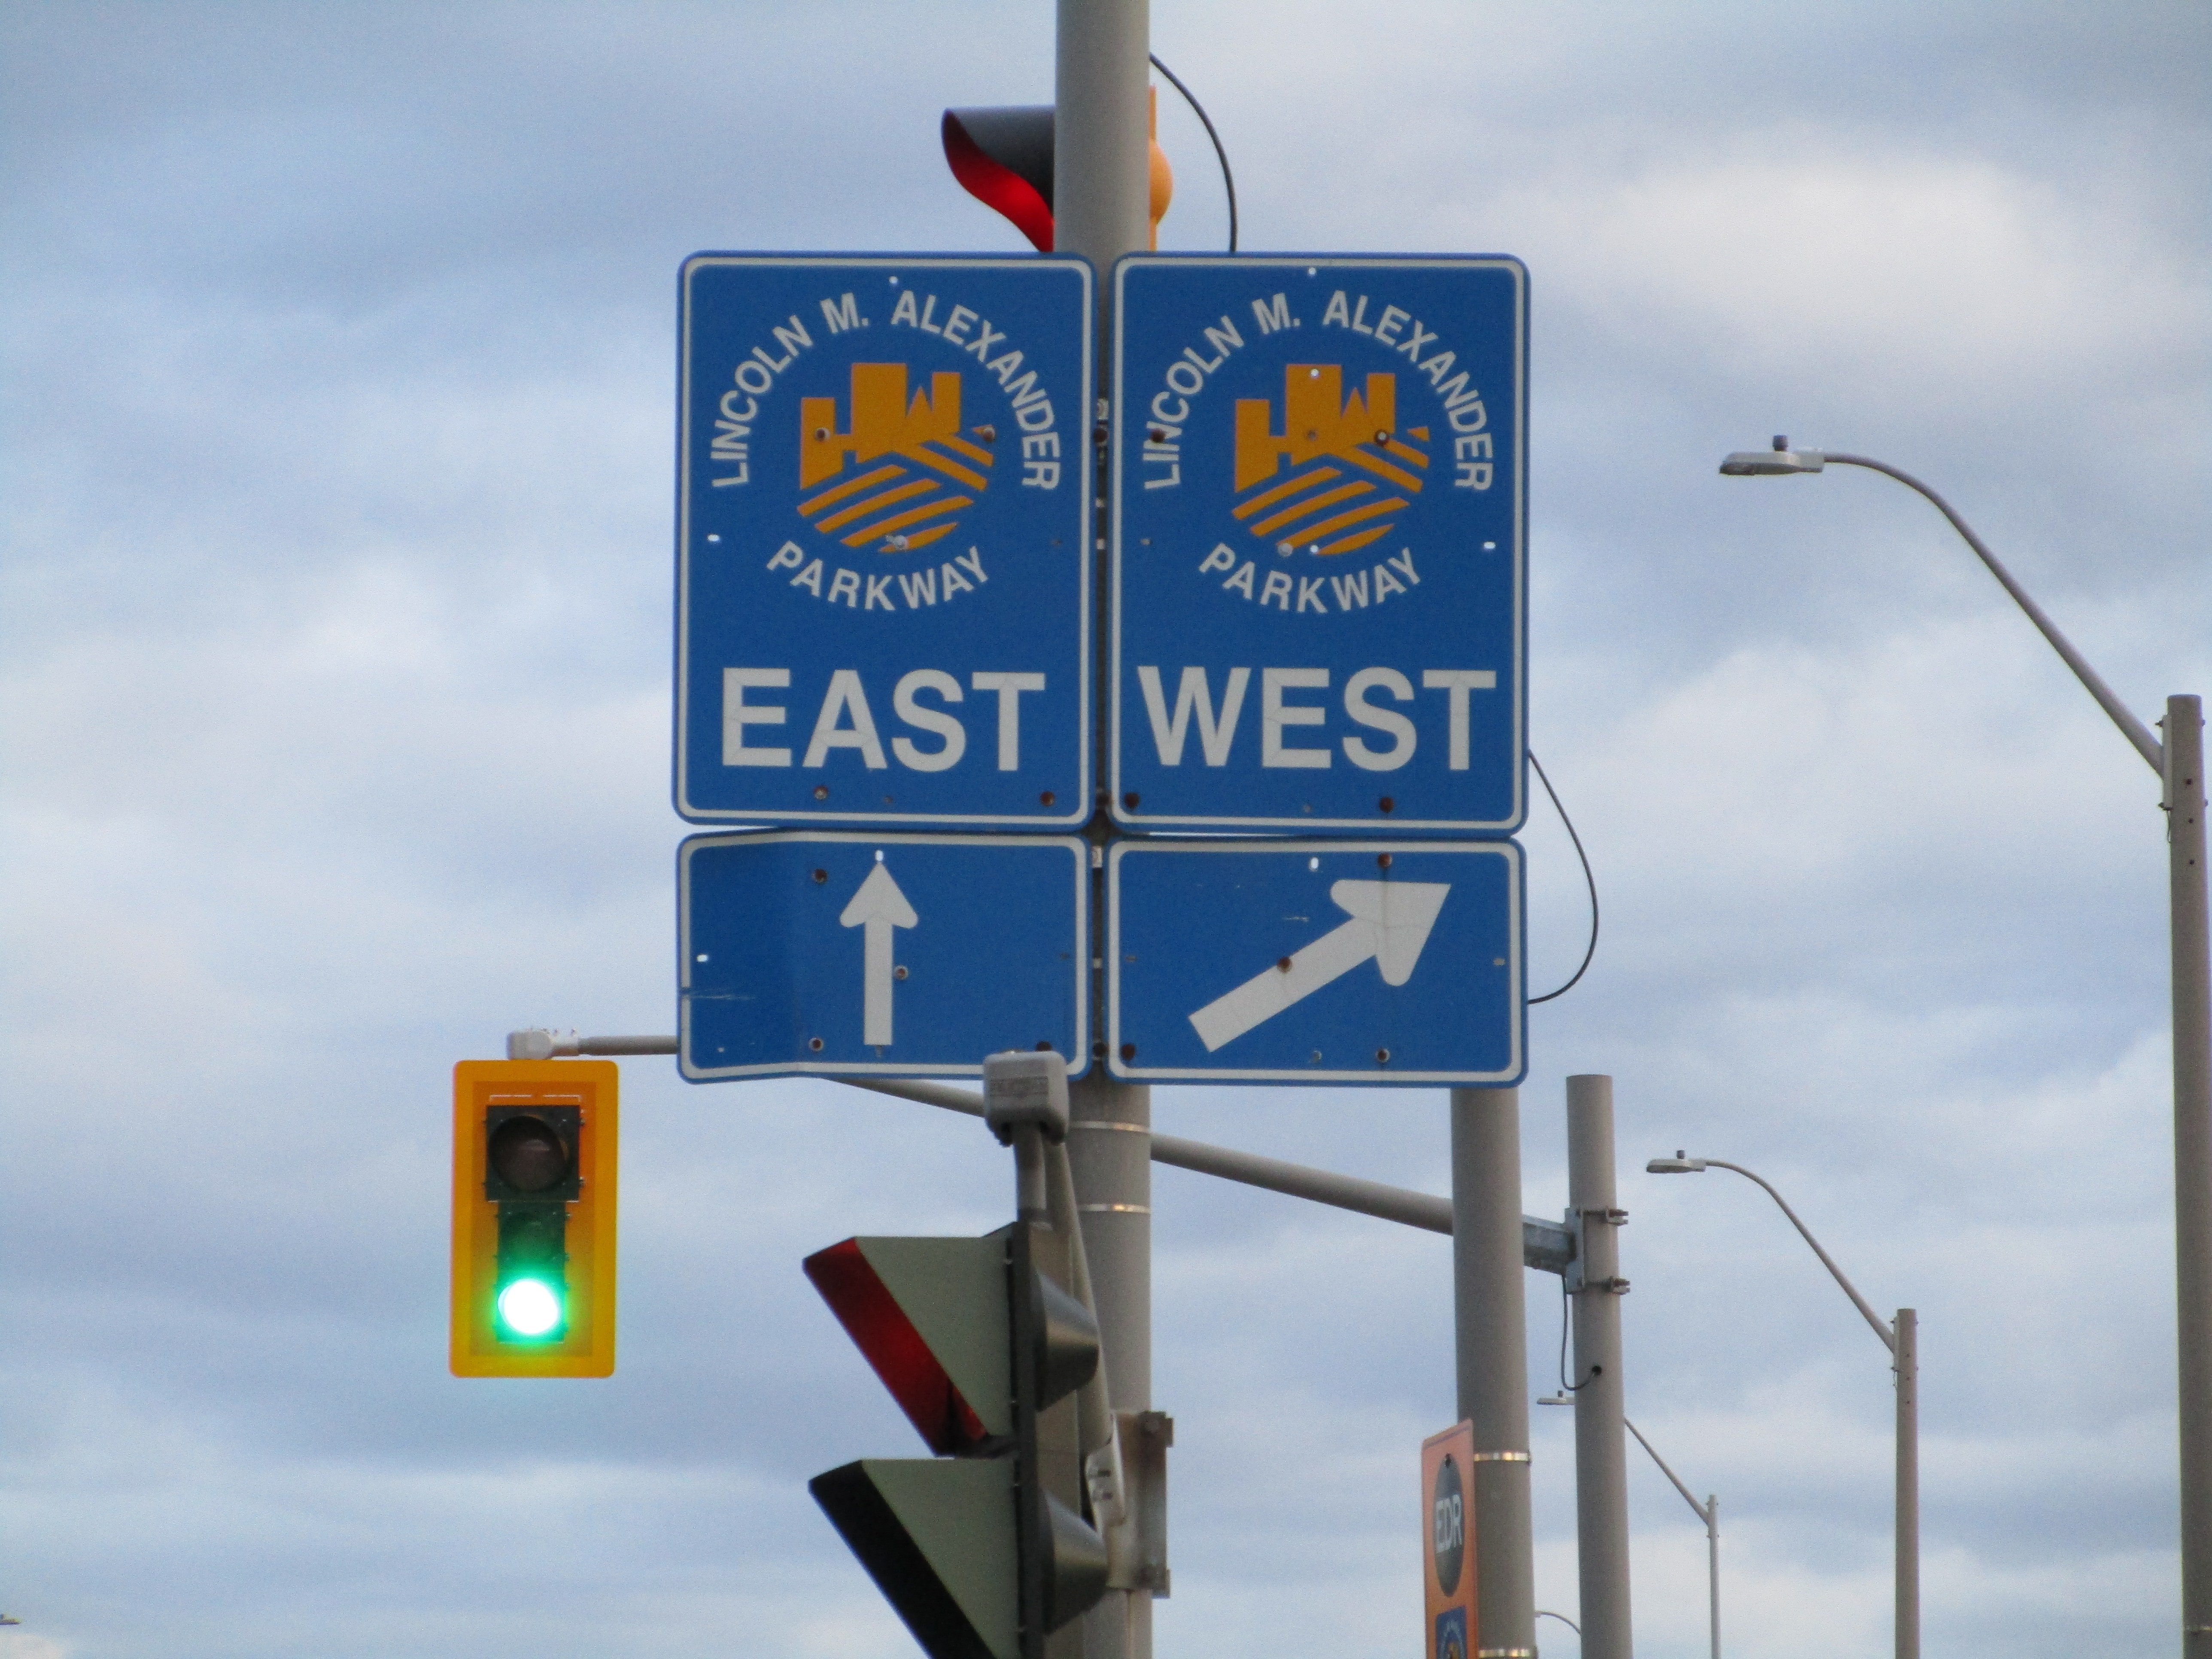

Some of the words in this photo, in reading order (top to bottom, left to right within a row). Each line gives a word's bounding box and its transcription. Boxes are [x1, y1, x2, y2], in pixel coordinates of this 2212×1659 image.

[710, 315, 813, 487] LINCOLN
[820, 292, 869, 334] M.
[890, 290, 1060, 490] ALEXANDER
[1142, 315, 1244, 489] LINCOLN
[1252, 292, 1301, 334] M.
[1323, 290, 1493, 491] ALEXANDER
[766, 540, 988, 611] PARKWAY
[1199, 543, 1420, 614] PARKWAY
[722, 667, 1046, 772] EAST
[1137, 665, 1497, 772] WEST
[1436, 1494, 1462, 1553] EDR
